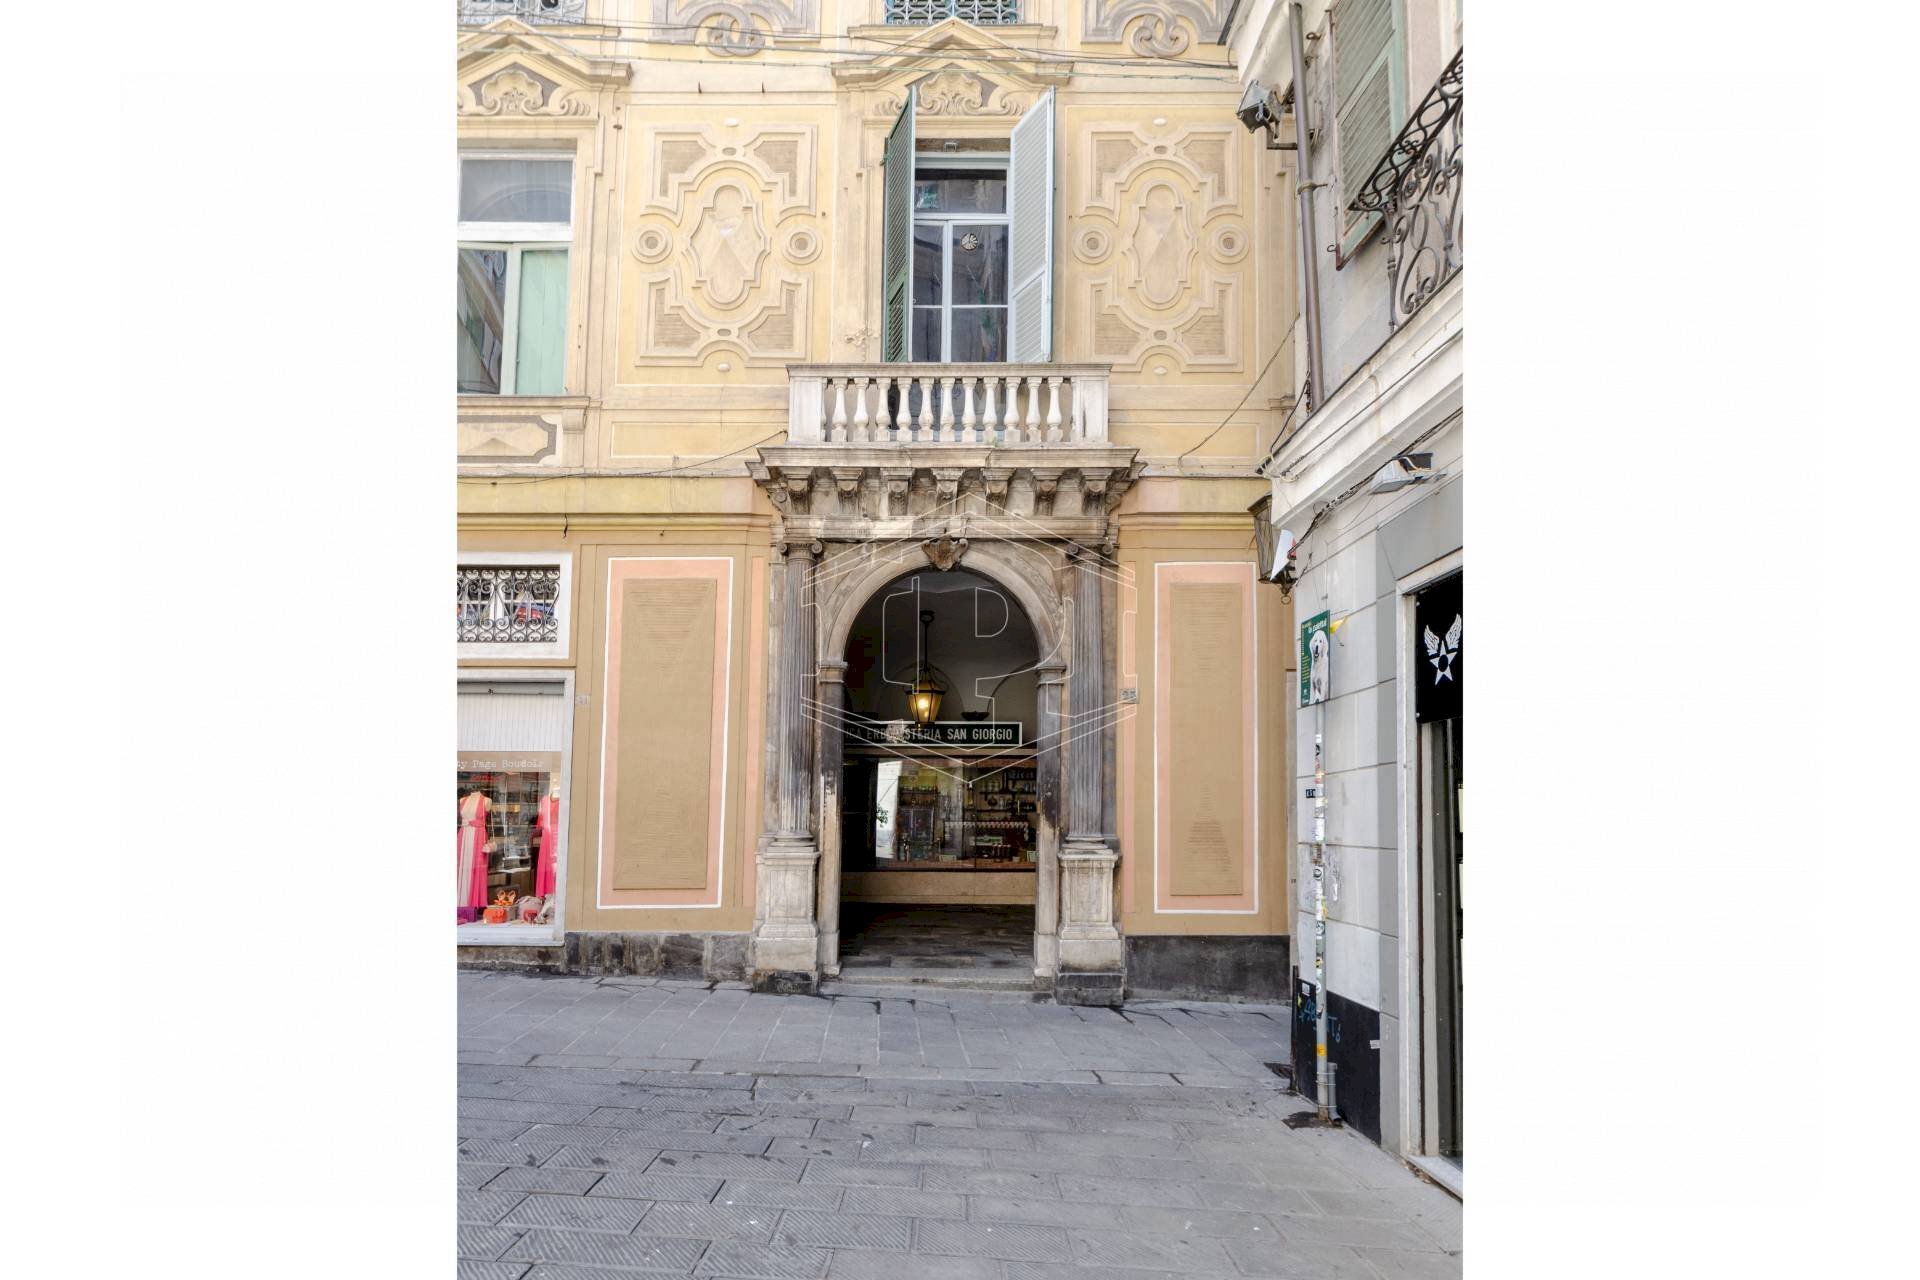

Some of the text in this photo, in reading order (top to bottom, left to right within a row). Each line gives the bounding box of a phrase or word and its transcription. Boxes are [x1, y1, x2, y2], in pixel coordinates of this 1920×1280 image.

[866, 728, 941, 740] ERBSTERIA
[947, 728, 967, 740] SAN
[972, 728, 1013, 740] GIORGIO
